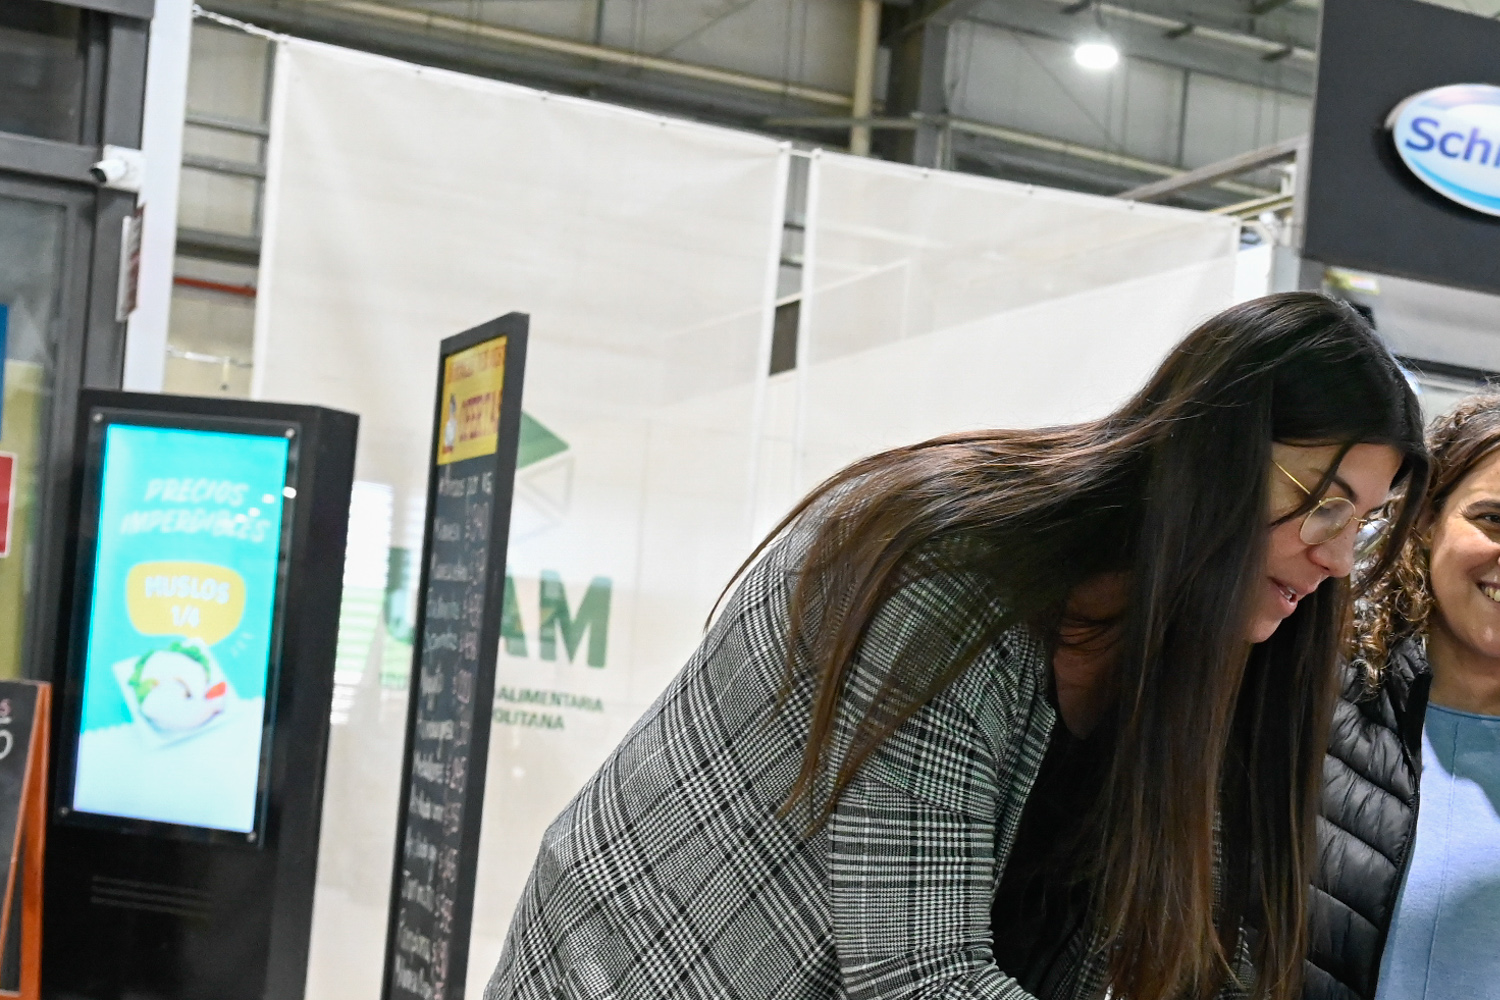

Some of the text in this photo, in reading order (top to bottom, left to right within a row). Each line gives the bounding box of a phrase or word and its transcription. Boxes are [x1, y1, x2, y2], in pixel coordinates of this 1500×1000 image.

[144, 478, 249, 507] PRECIOS
[145, 574, 231, 605] MUSLOS
[170, 604, 201, 628] 1/4
